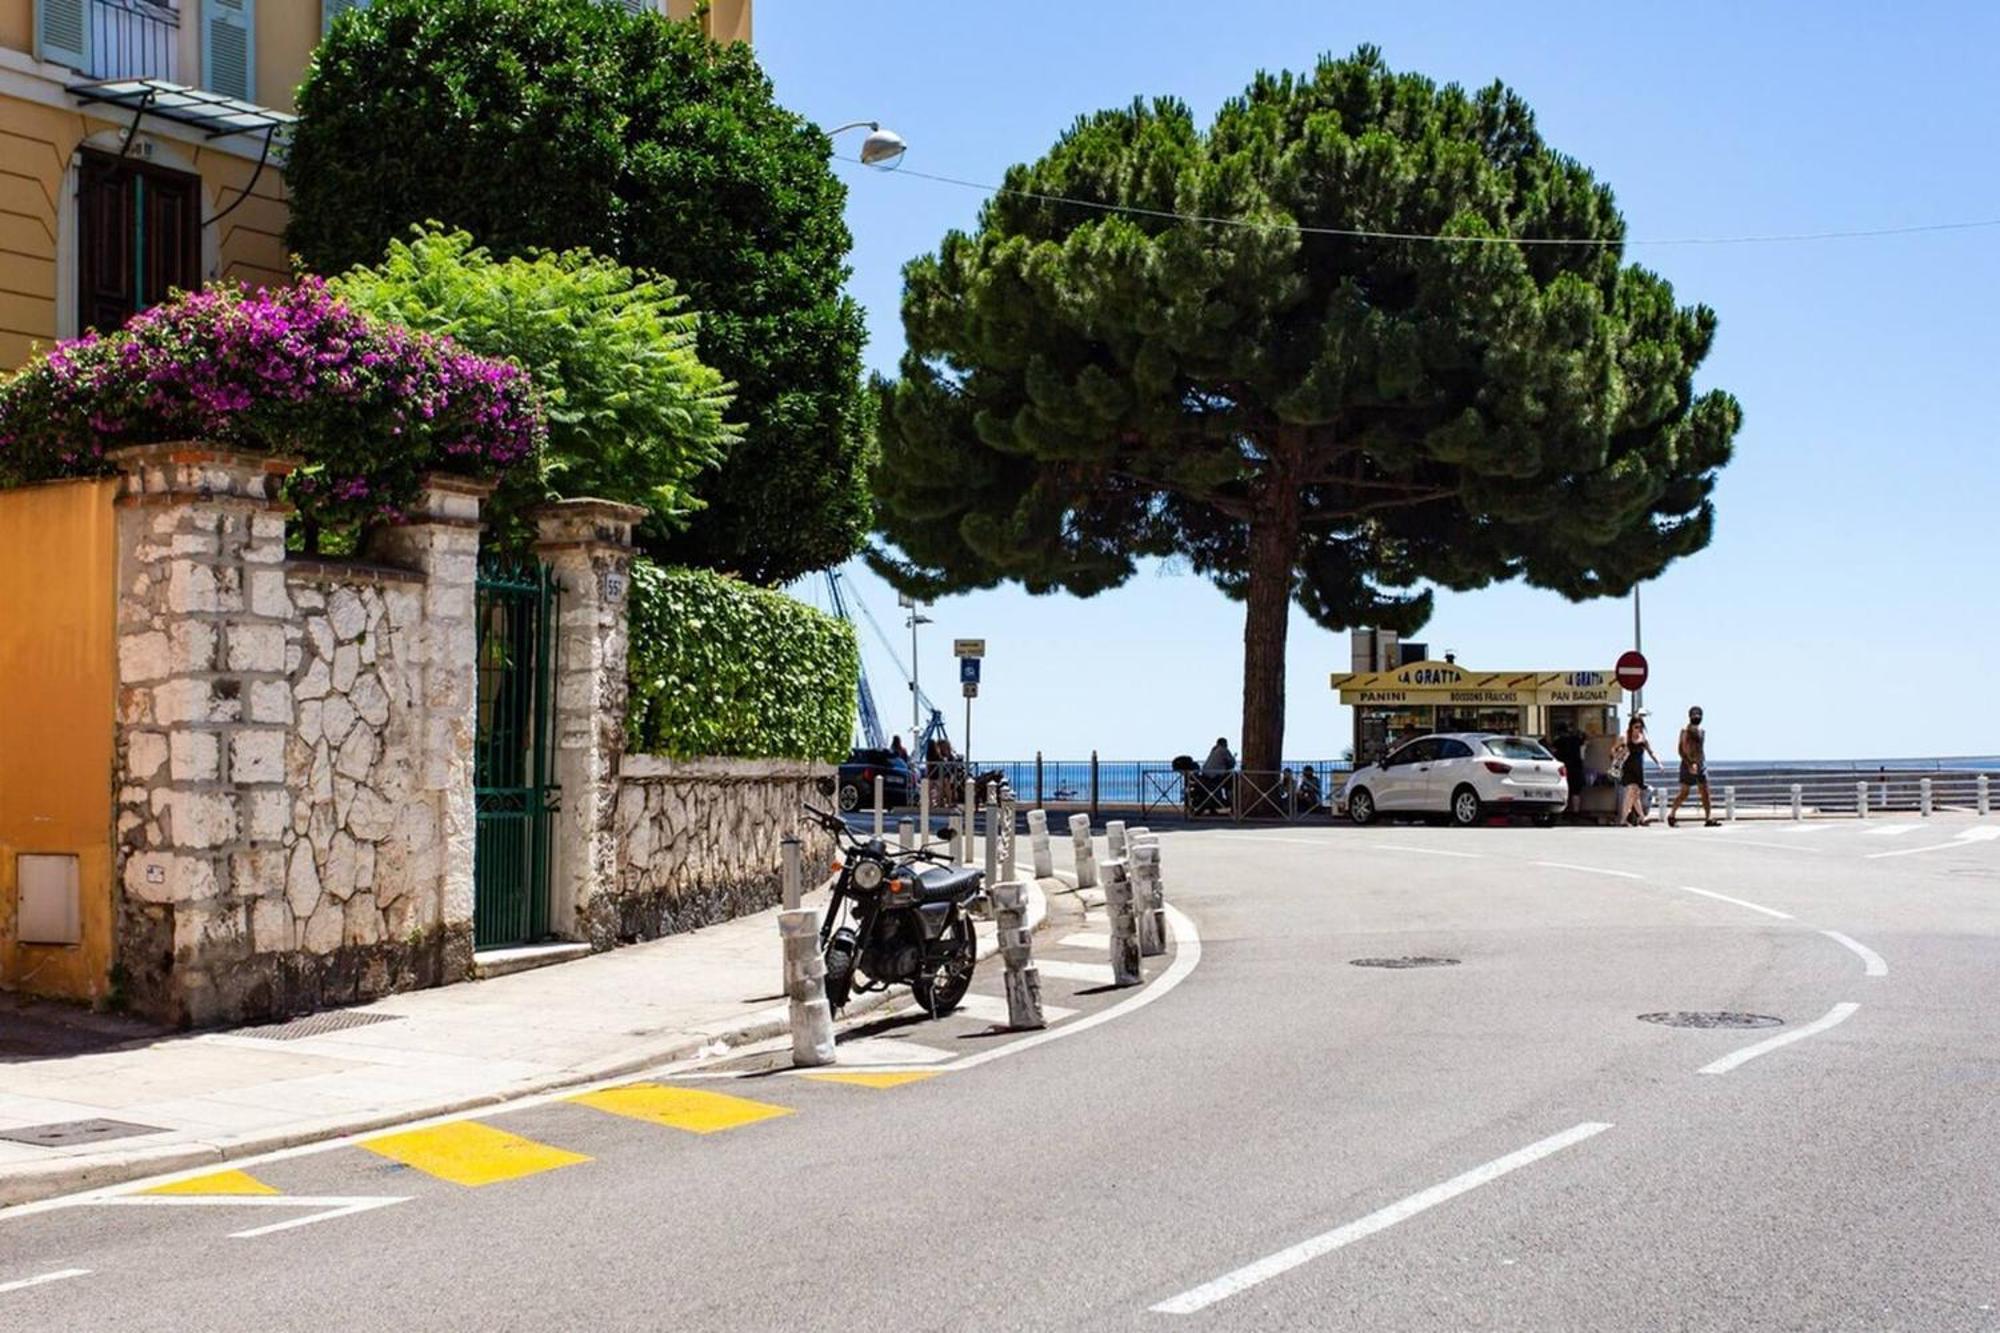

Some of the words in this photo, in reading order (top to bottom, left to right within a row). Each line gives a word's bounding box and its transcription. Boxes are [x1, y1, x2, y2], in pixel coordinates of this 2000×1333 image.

[1398, 671, 1410, 684] LA
[1415, 669, 1462, 684] GRATTA
[1360, 692, 1407, 702] PANINI
[1450, 691, 1483, 702] BOISSONS
[1551, 690, 1570, 701] PAN
[1572, 690, 1608, 701] BAGNAT
